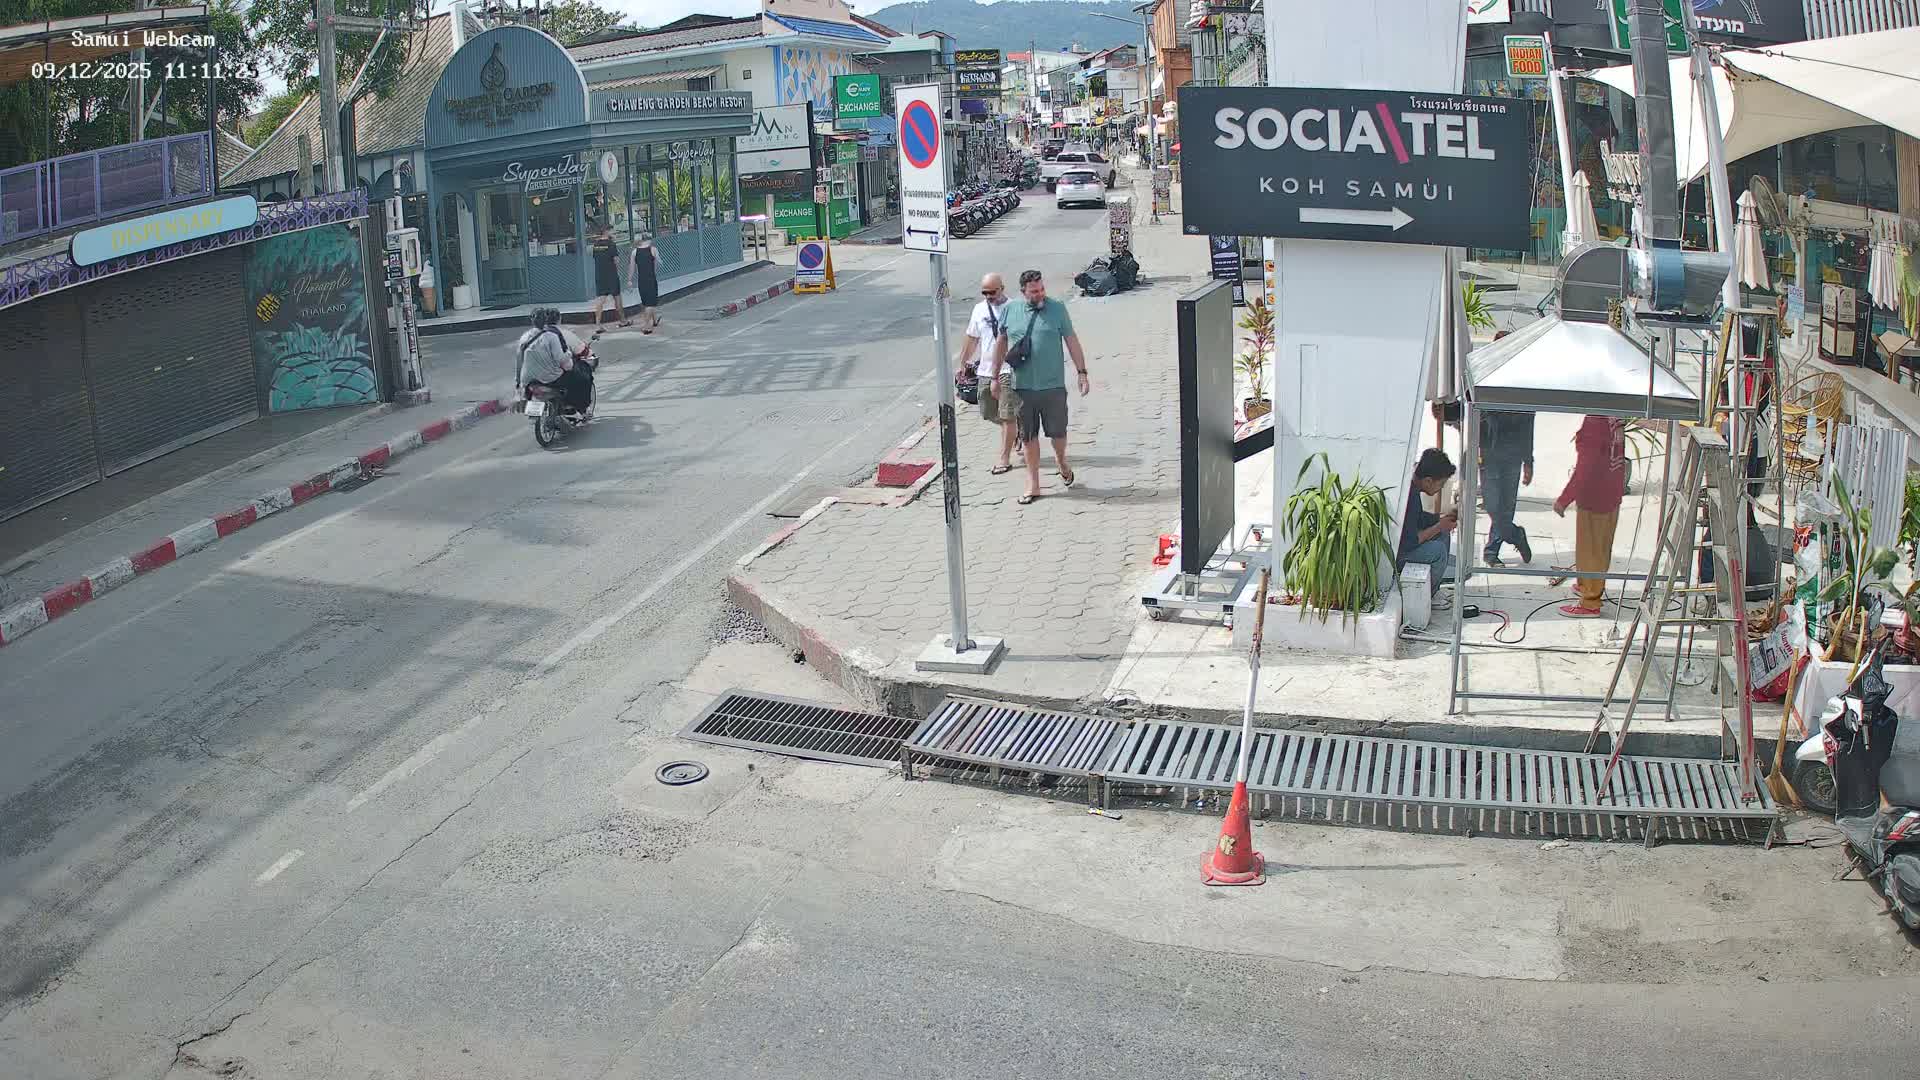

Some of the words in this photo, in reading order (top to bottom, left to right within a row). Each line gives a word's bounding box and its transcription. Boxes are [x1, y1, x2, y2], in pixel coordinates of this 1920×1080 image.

[1509, 47, 1542, 59] INDIAN
[1512, 60, 1542, 73] FOOD
[611, 98, 655, 111] CHAWENG
[658, 97, 690, 109] GARDEN
[693, 97, 718, 109] BEACH
[720, 96, 746, 108] RESORT
[839, 102, 879, 112] EXCHANGE
[740, 133, 799, 144] CHAWENG
[1259, 177, 1325, 195] KOH
[1347, 179, 1453, 201] SAMUI
[774, 208, 813, 218] EXCHANGE
[908, 209, 916, 217] NO
[916, 210, 940, 219] PARKING
[111, 208, 223, 252] DISPENSARY
[302, 303, 347, 317] THAILAND
